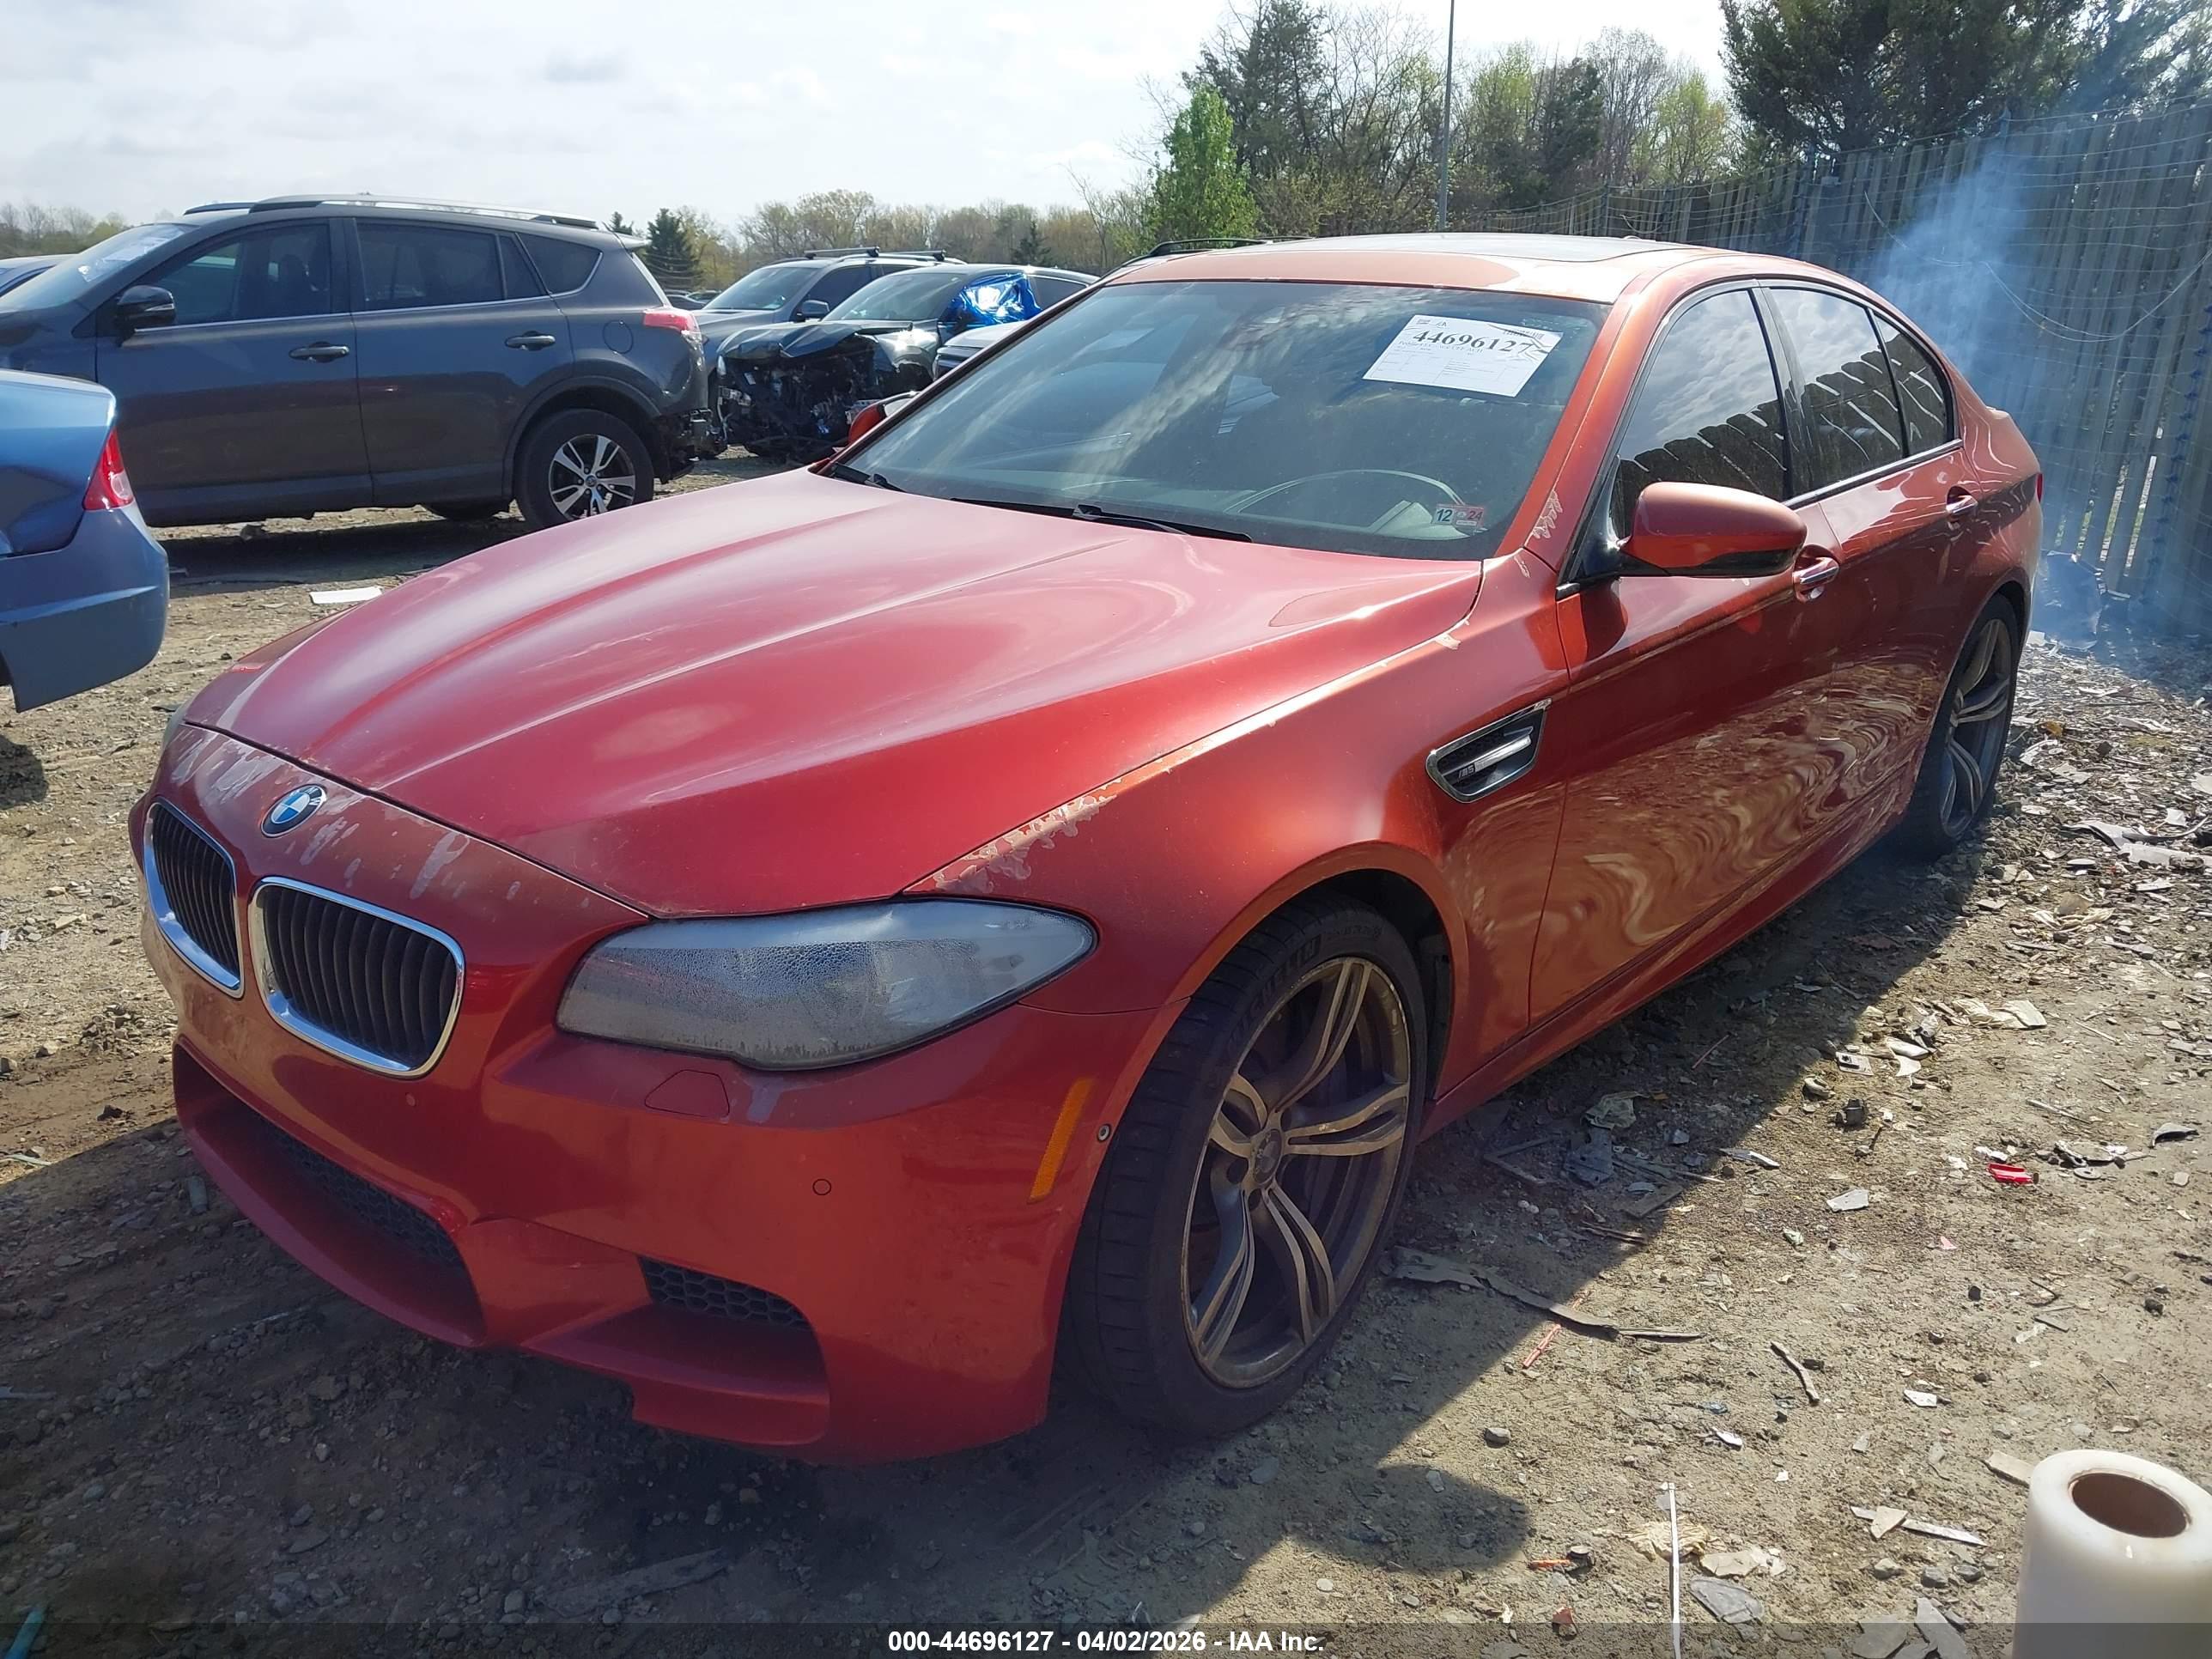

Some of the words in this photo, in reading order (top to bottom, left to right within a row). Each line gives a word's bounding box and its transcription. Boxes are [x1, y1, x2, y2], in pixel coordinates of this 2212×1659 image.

[1413, 330, 1534, 354] 44696127
[1437, 508, 1453, 522] 12
[1468, 510, 1483, 521] 24
